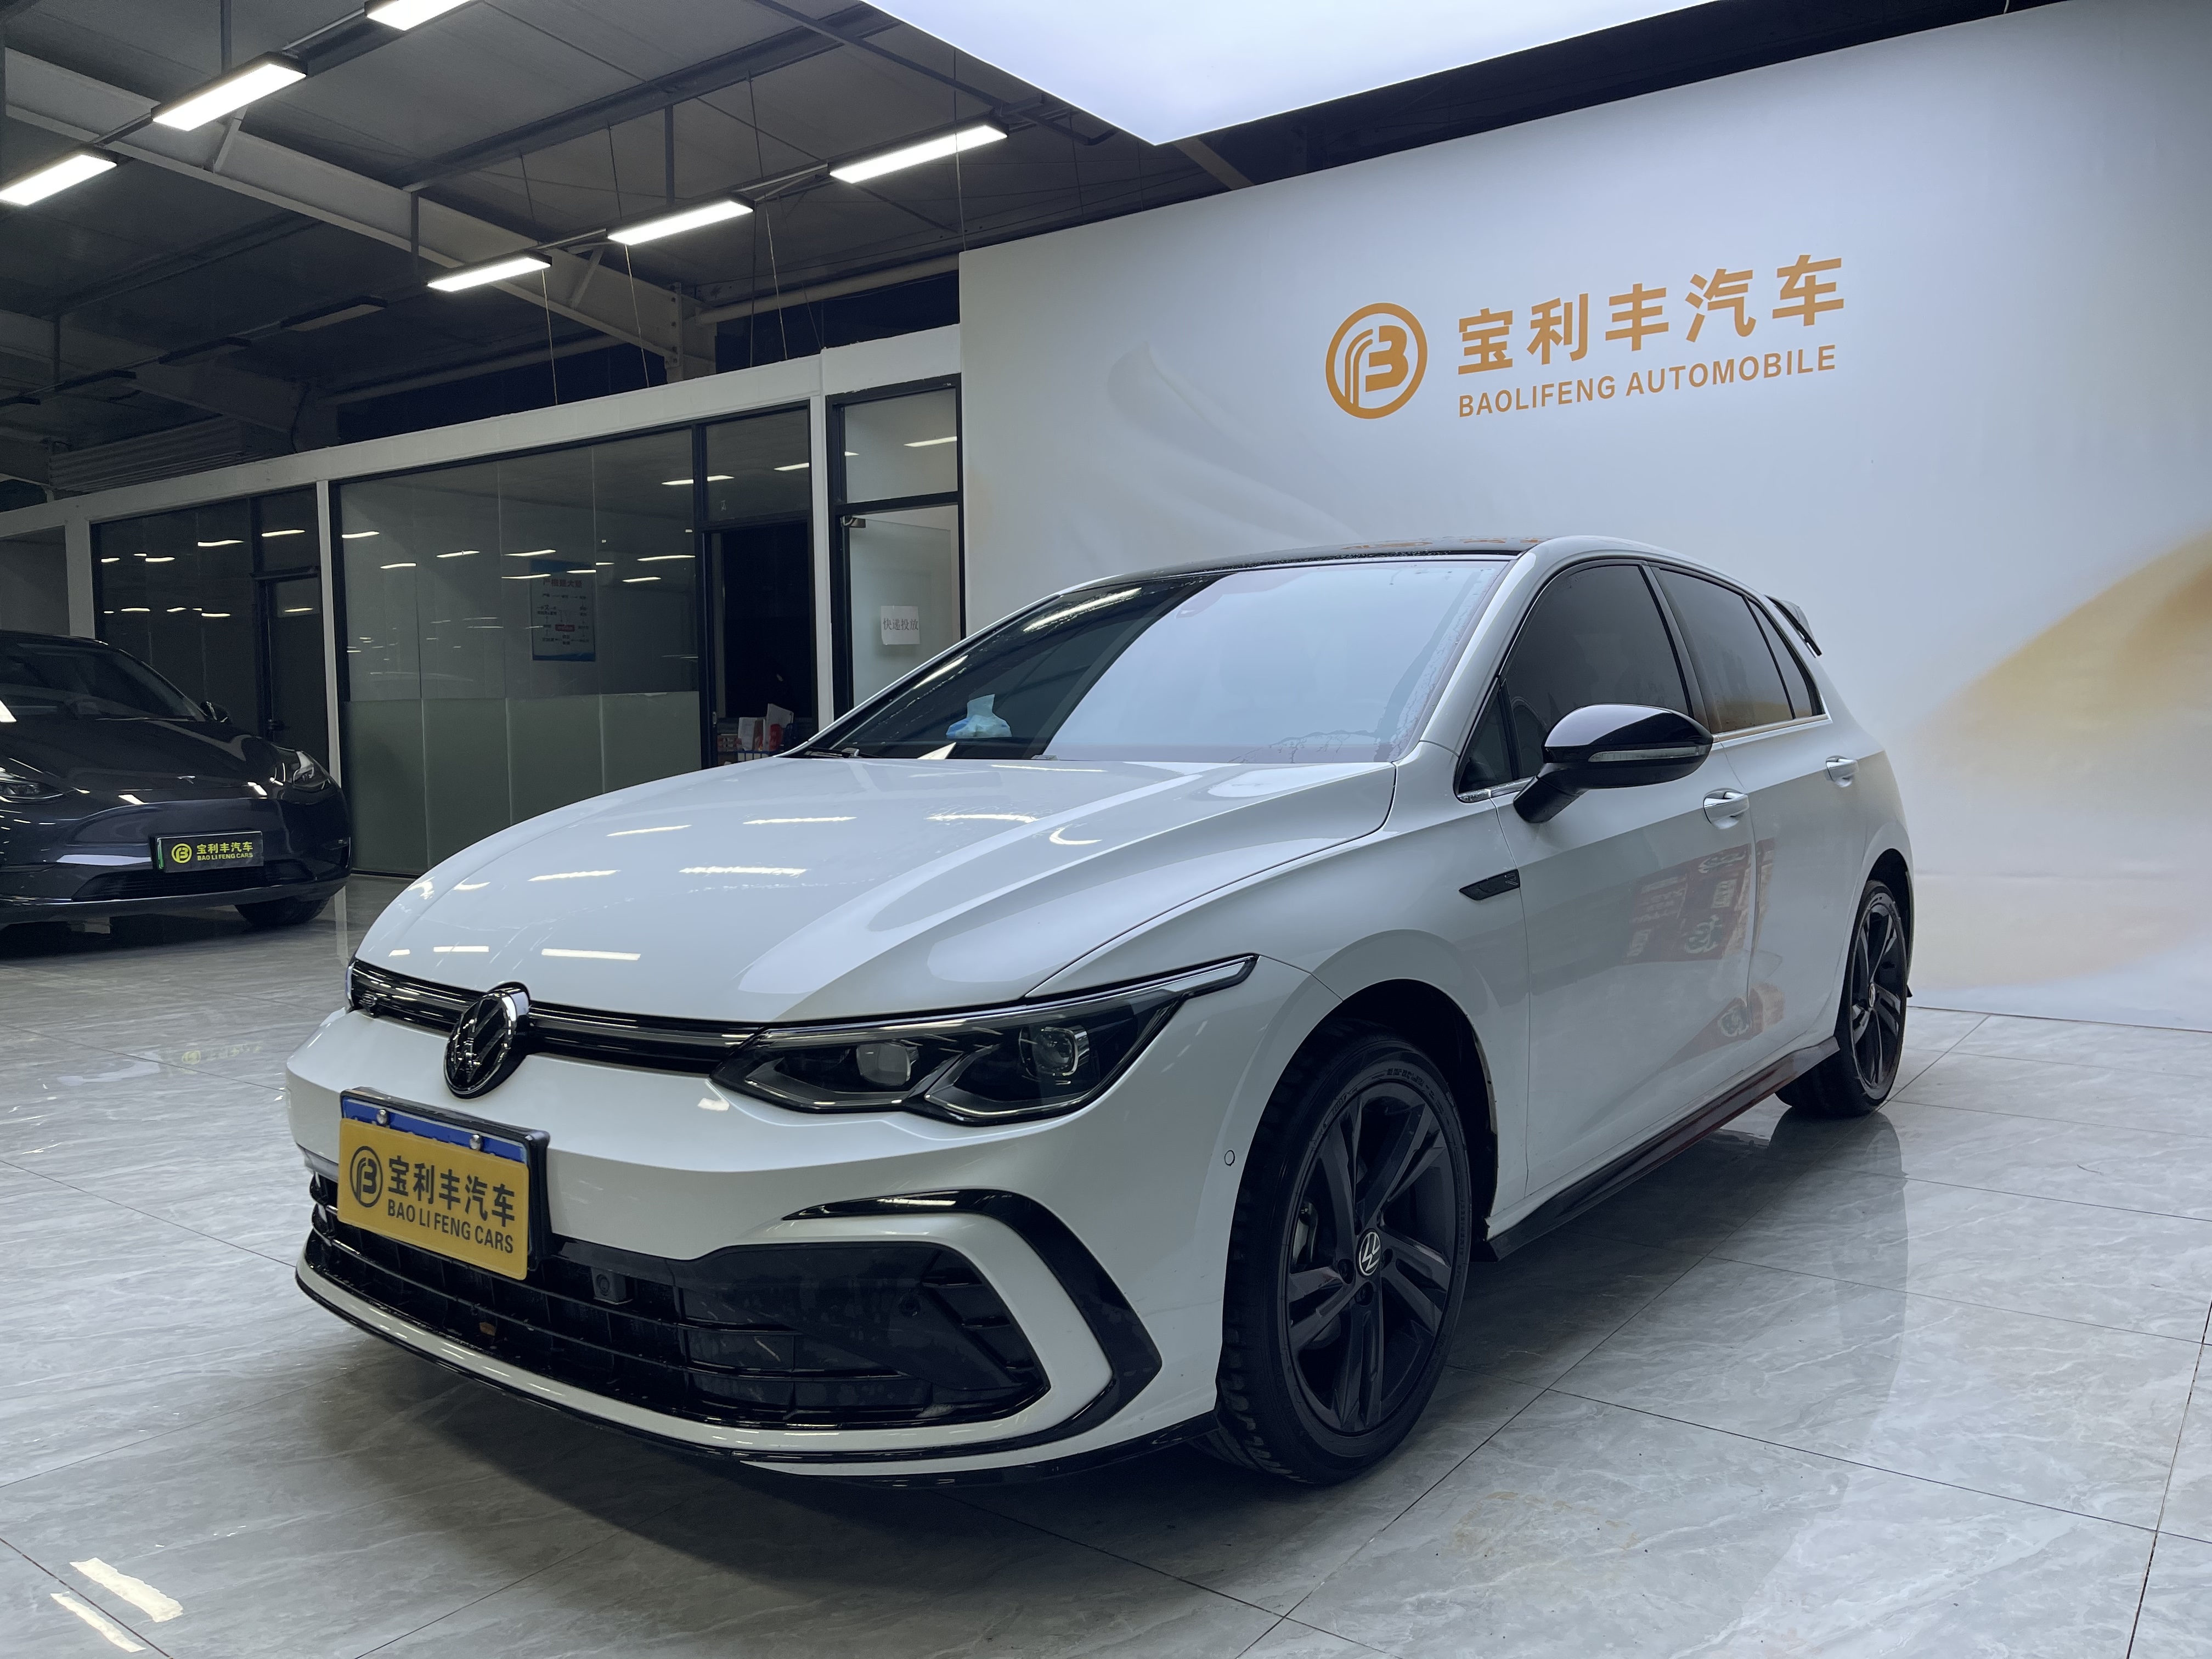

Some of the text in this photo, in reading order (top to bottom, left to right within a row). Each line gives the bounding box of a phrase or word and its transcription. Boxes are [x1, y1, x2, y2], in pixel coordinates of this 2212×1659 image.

[1457, 254, 1845, 375] 宝利丰汽车
[1459, 344, 1836, 417] BAOLIFENG AUTOMOBILE
[883, 618, 919, 630] 快递投放
[196, 841, 253, 855] 宝利丰汽车
[388, 1155, 515, 1228] 宝利丰汽车
[388, 1199, 514, 1254] BAO LI FENG CARS
